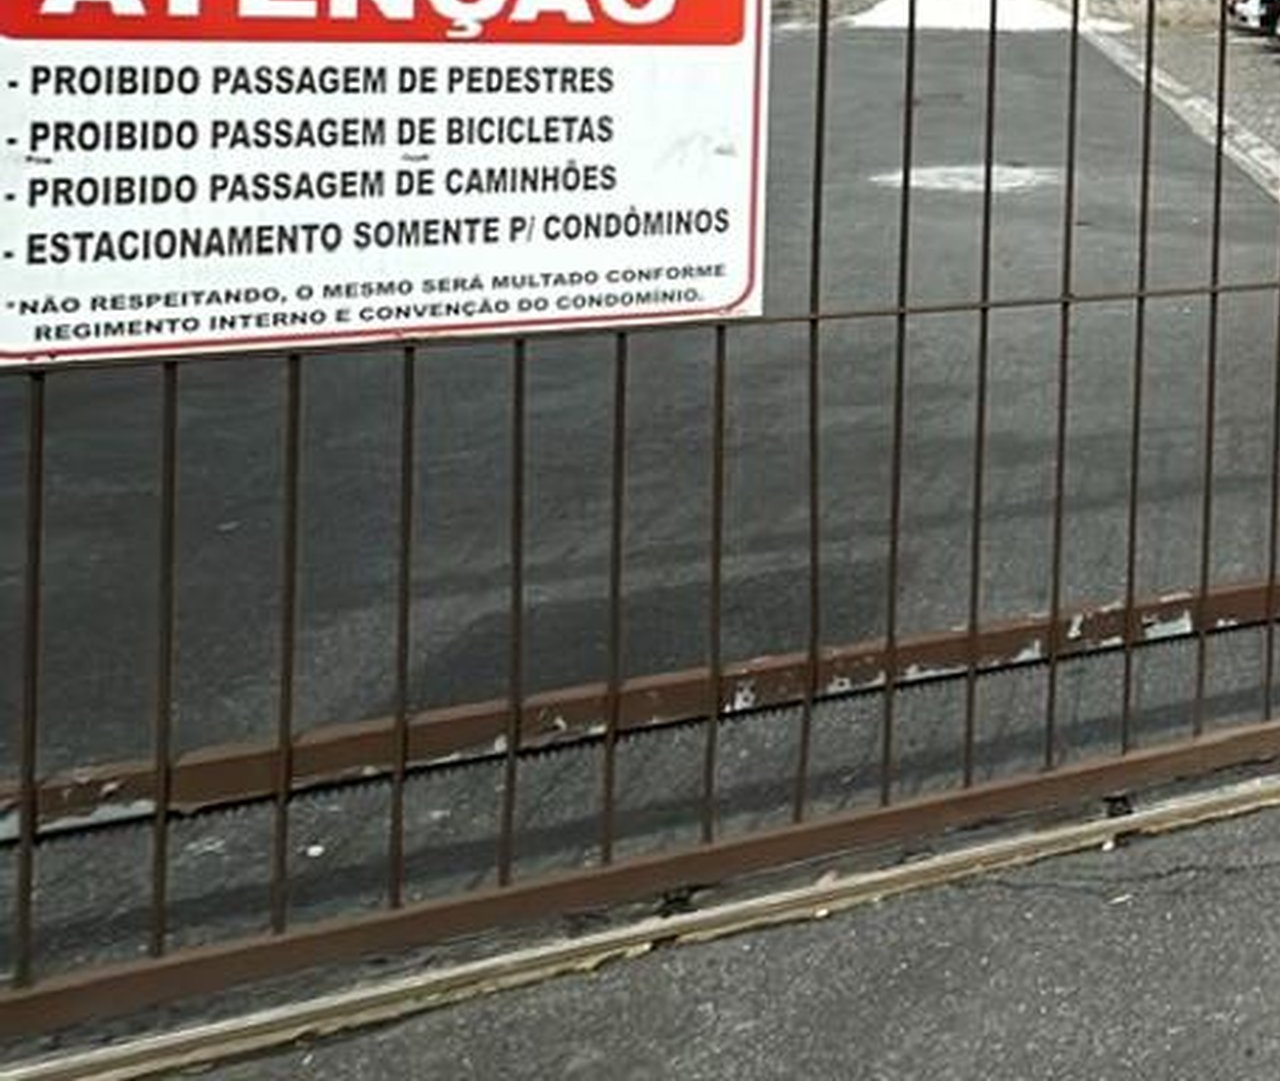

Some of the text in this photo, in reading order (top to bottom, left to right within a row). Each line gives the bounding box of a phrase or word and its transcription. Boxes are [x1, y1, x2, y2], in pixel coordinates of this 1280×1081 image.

[31, 66, 200, 95] PROIBIDO
[212, 66, 387, 94] PASSAGEM
[398, 67, 437, 93] DE
[447, 67, 614, 94] PEDESTRES
[30, 120, 198, 152] PROIBIDO
[210, 118, 386, 149] PASSAGEM
[397, 118, 436, 145] DE
[446, 115, 614, 145] BICICLETAS
[28, 174, 197, 208] PROIBIDO
[209, 170, 385, 203] PASSAGEM
[396, 169, 435, 196] DE
[445, 159, 617, 195] CAMINHÕES
[27, 222, 342, 265] ESTACIONAMENTO
[353, 217, 500, 250] SOMENTE
[509, 216, 536, 242] P/
[543, 205, 730, 241] CONDÔMINOS
[90, 286, 288, 312] RESPEITANDO,
[295, 284, 314, 301] O
[322, 279, 413, 299] MESMO
[421, 273, 485, 294] SERÁ
[491, 270, 599, 291] MULTADO
[605, 263, 726, 284] CONFORME
[34, 317, 200, 342] REGIMENTO
[209, 310, 327, 331] INTERNO
[335, 309, 350, 323] E
[358, 299, 510, 322] CONVENÇÃO
[517, 297, 550, 313] DO
